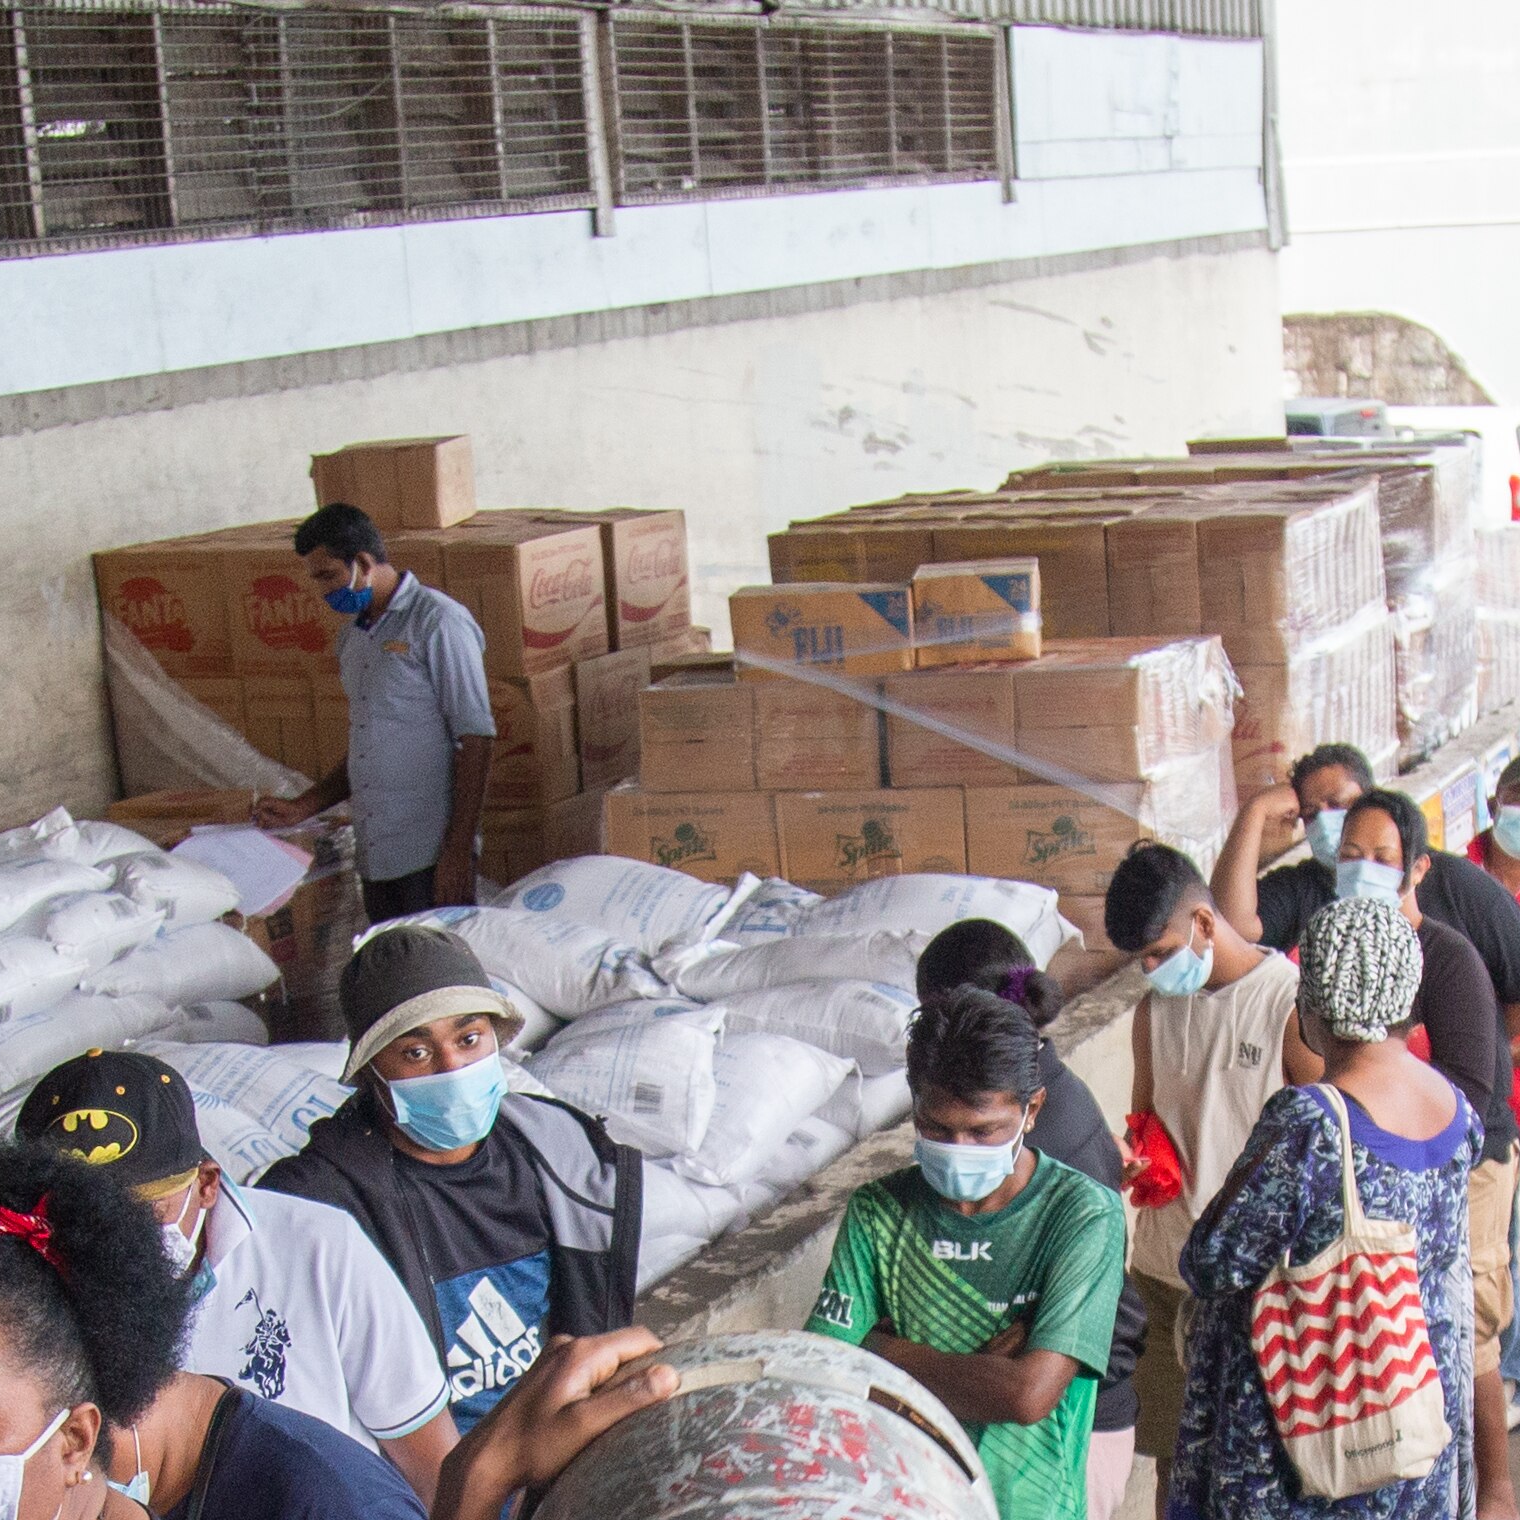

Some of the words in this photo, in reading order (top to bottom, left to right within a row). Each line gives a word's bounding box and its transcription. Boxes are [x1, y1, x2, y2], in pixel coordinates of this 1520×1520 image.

[792, 624, 845, 666] FIJI
[932, 1239, 993, 1262] BLK
[450, 1325, 543, 1404] didas
